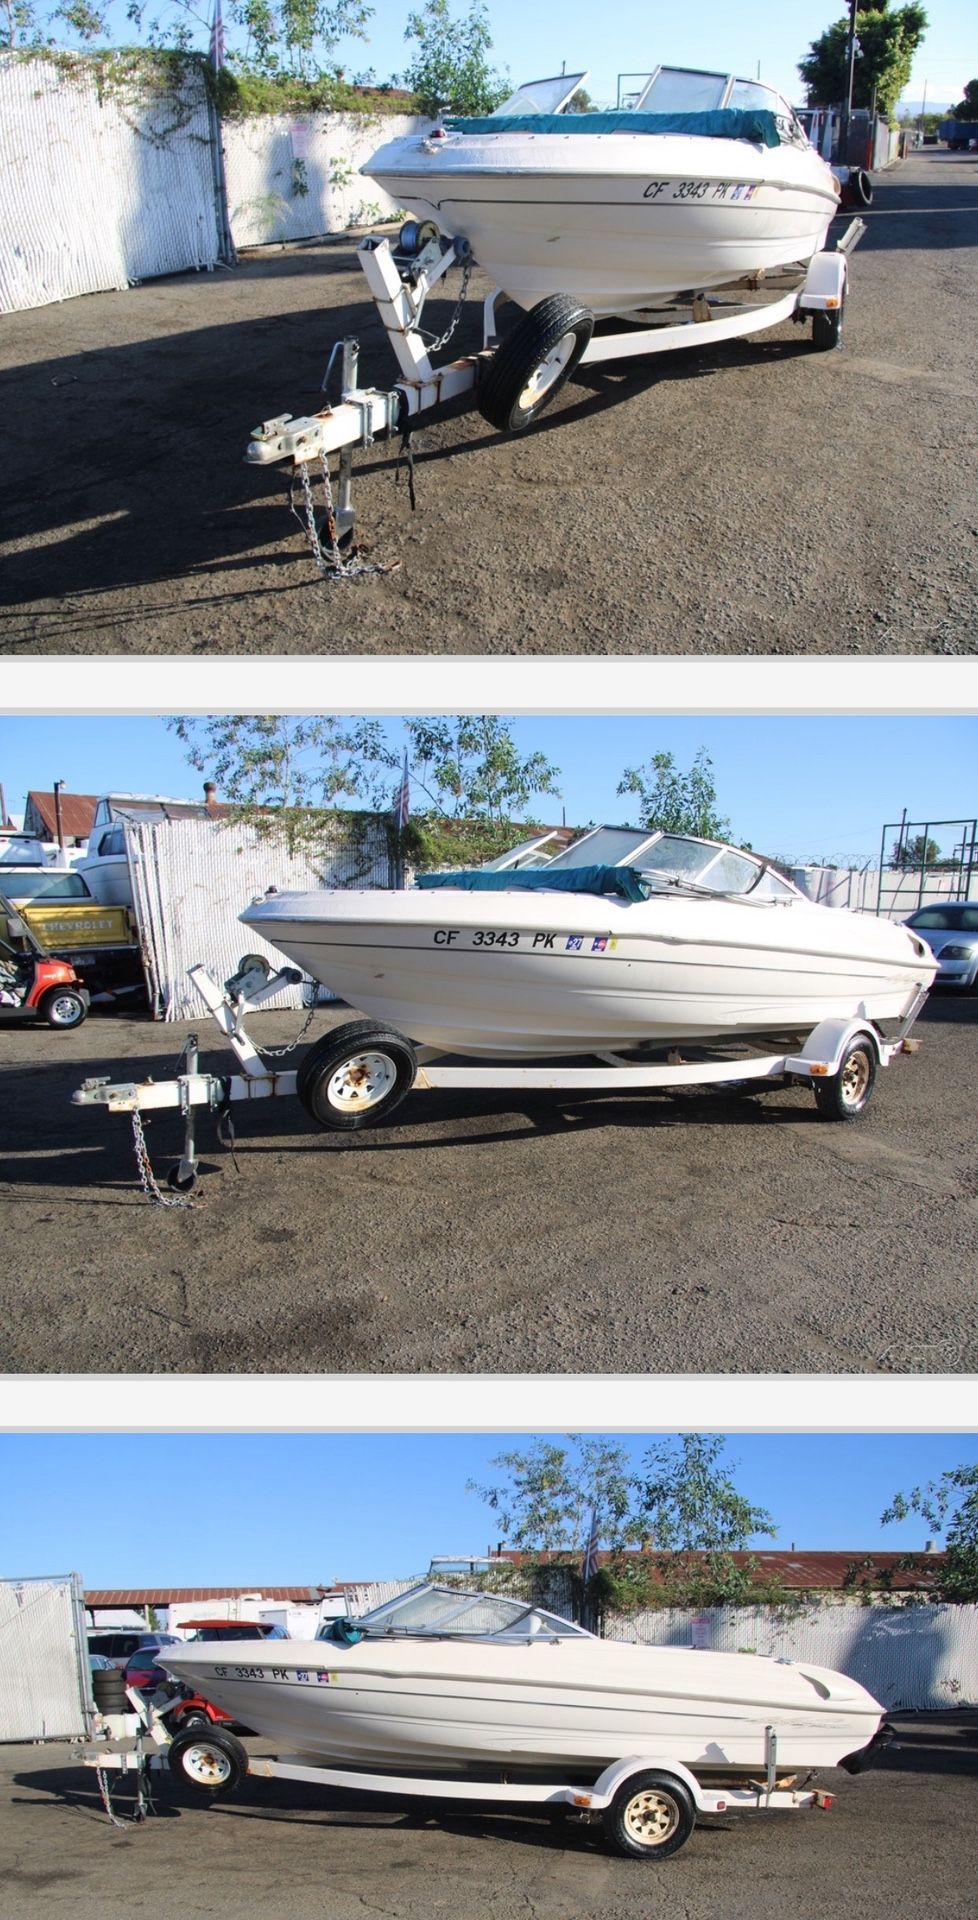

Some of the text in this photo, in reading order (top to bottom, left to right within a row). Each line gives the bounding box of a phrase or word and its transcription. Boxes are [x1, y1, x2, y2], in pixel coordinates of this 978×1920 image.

[643, 182, 669, 199] CF
[672, 182, 710, 199] 3343
[712, 182, 731, 198] PK
[42, 920, 113, 931] CHEVROLET
[433, 930, 557, 949] CF 3343 PK
[214, 1666, 290, 1680] CF 3343 PK
